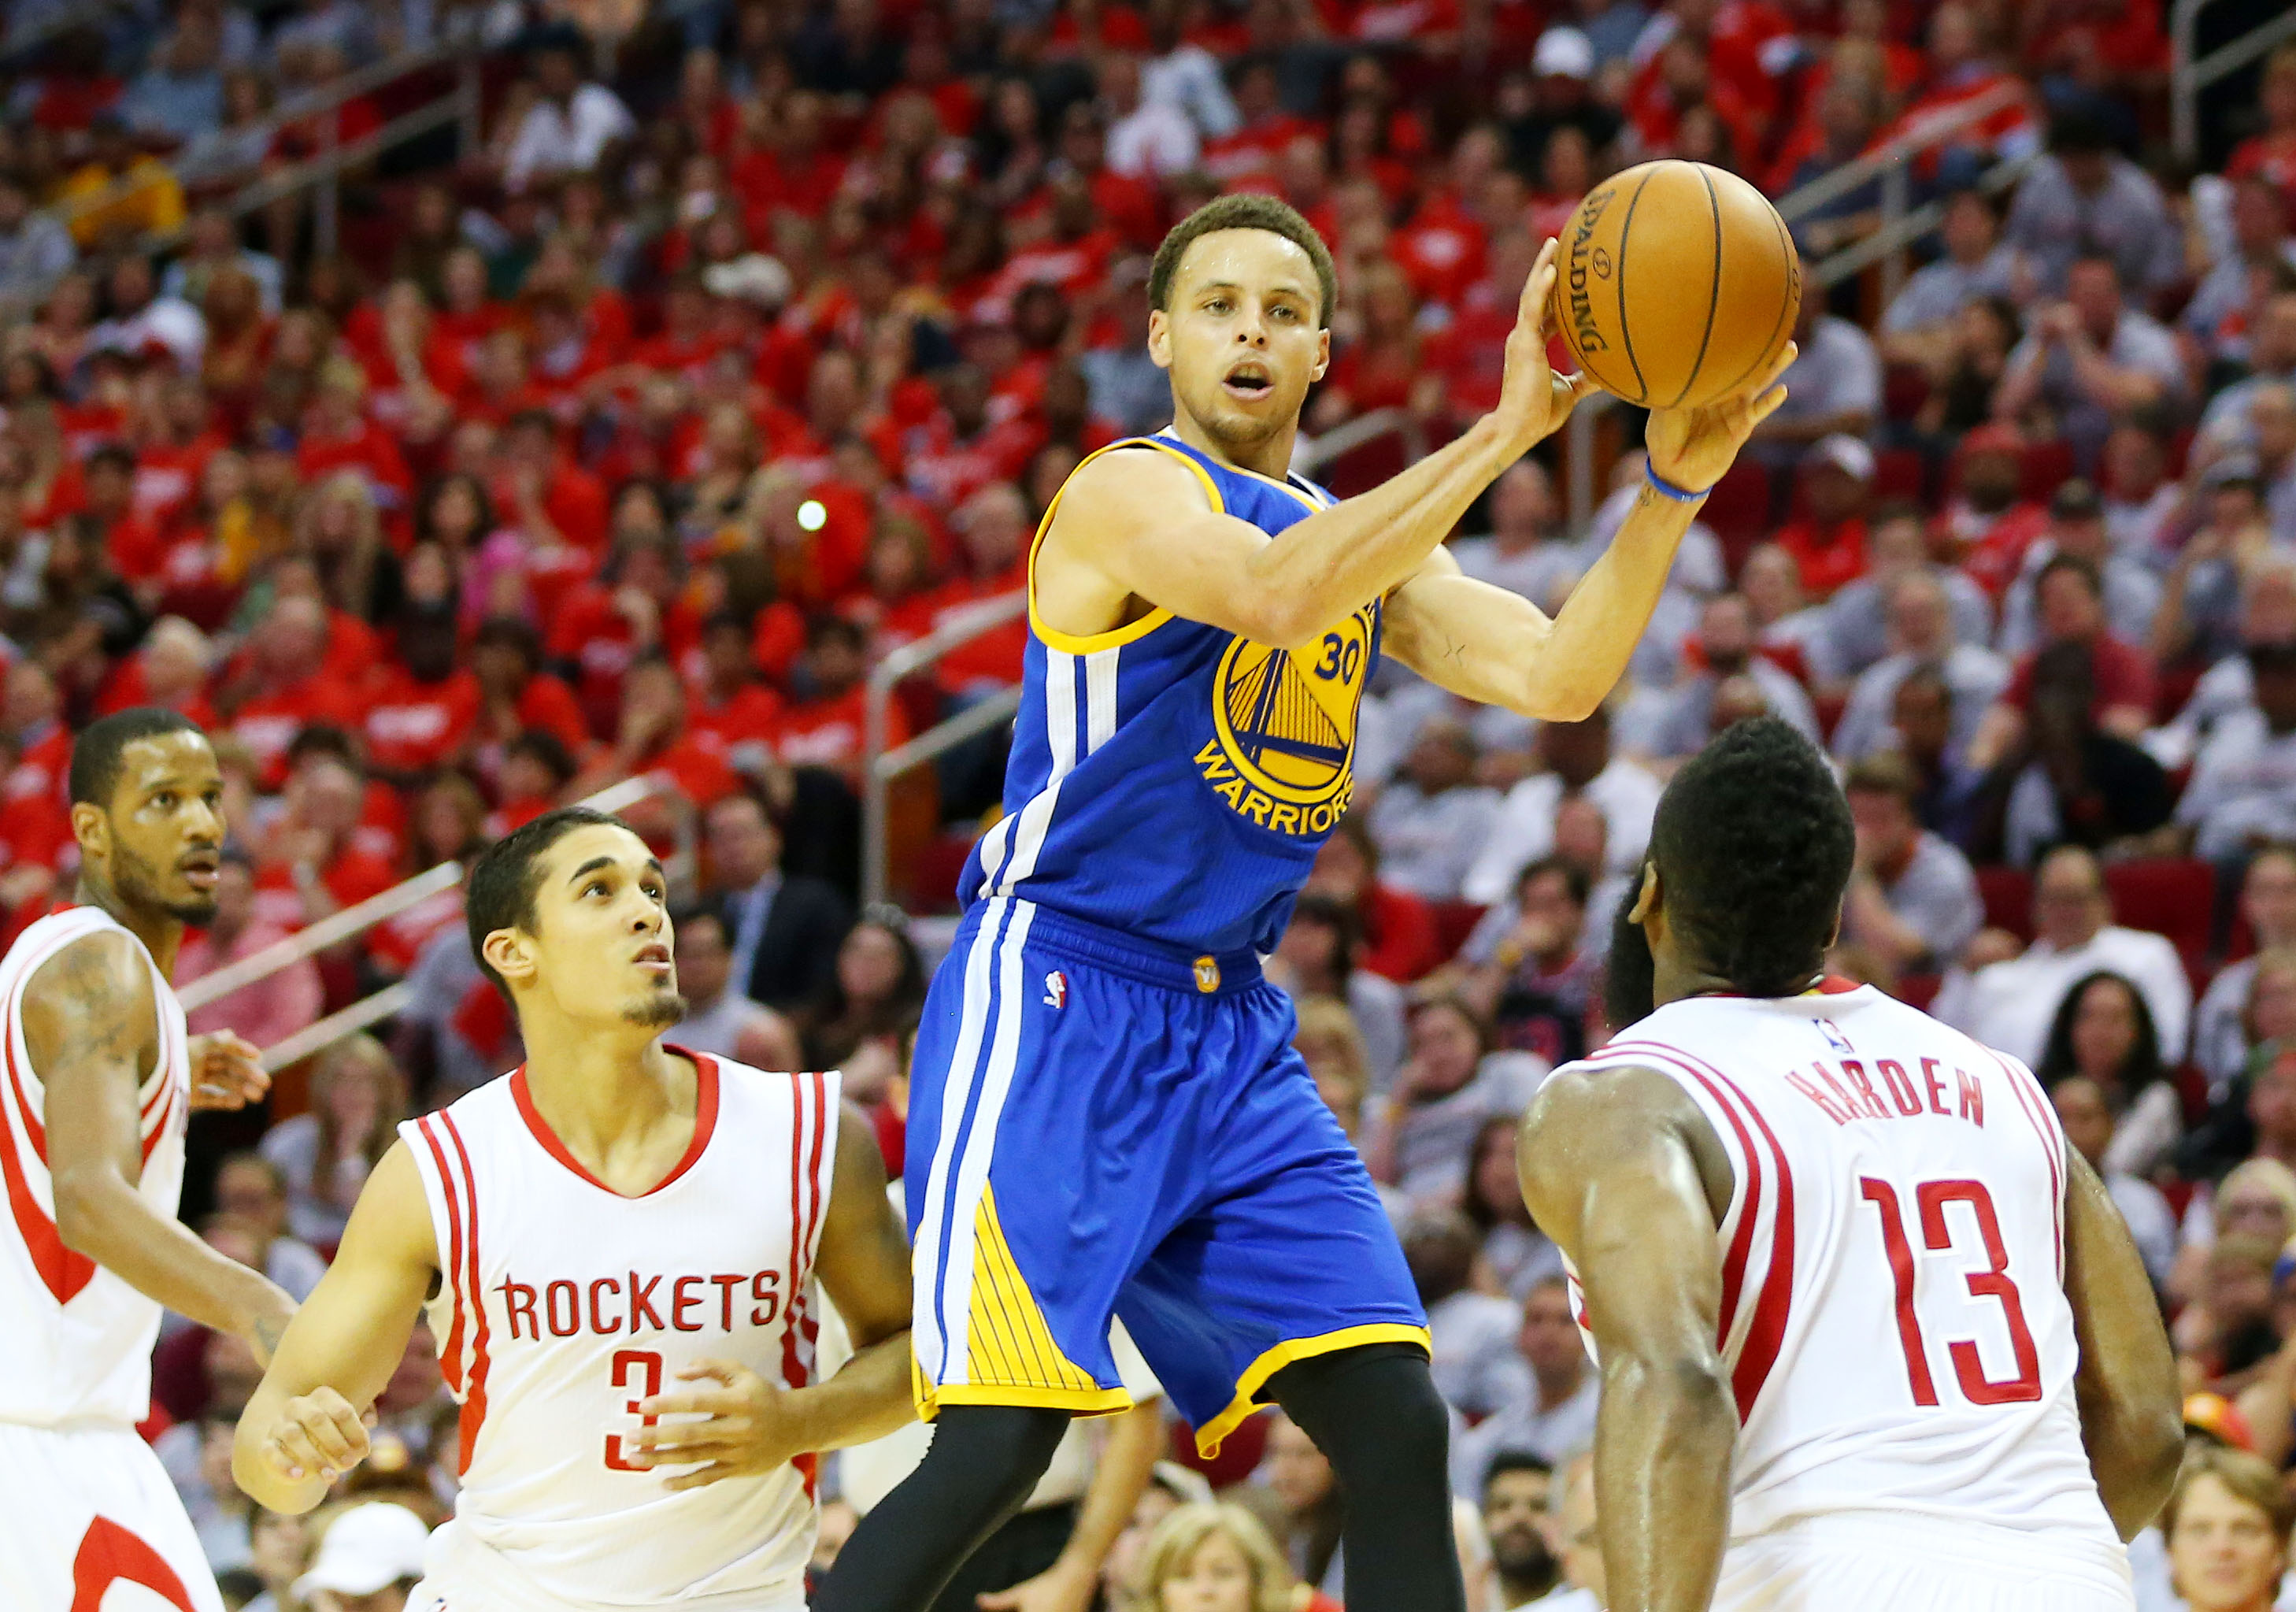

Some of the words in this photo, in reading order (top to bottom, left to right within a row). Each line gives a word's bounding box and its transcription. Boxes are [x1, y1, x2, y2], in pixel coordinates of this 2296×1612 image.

[1315, 632, 1359, 686] 30
[1193, 738, 1355, 836] WARRIORS
[1784, 1056, 1984, 1129] HARDEN
[494, 1269, 781, 1341] ROCKETS
[1859, 1175, 2042, 1406] 13
[604, 1349, 662, 1472] 3
